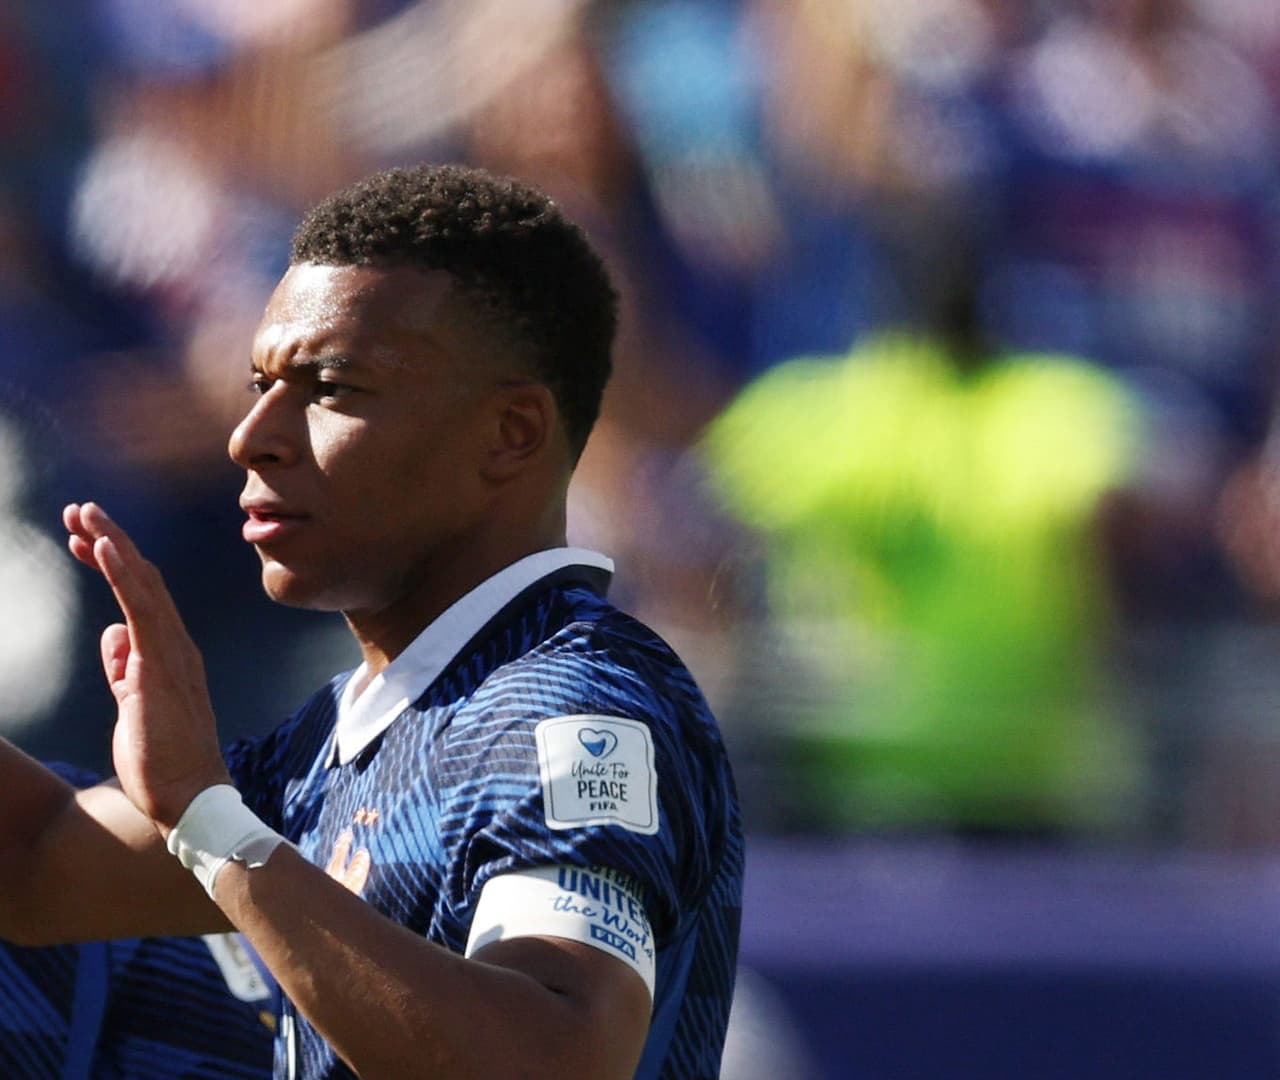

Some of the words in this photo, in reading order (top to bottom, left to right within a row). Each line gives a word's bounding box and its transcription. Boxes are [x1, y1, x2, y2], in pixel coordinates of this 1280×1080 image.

[571, 760, 608, 779] Unite
[609, 762, 630, 779] For
[577, 780, 628, 802] PEACE
[589, 801, 618, 812] FIFA
[553, 896, 597, 917] the
[592, 925, 635, 959] FIFA
